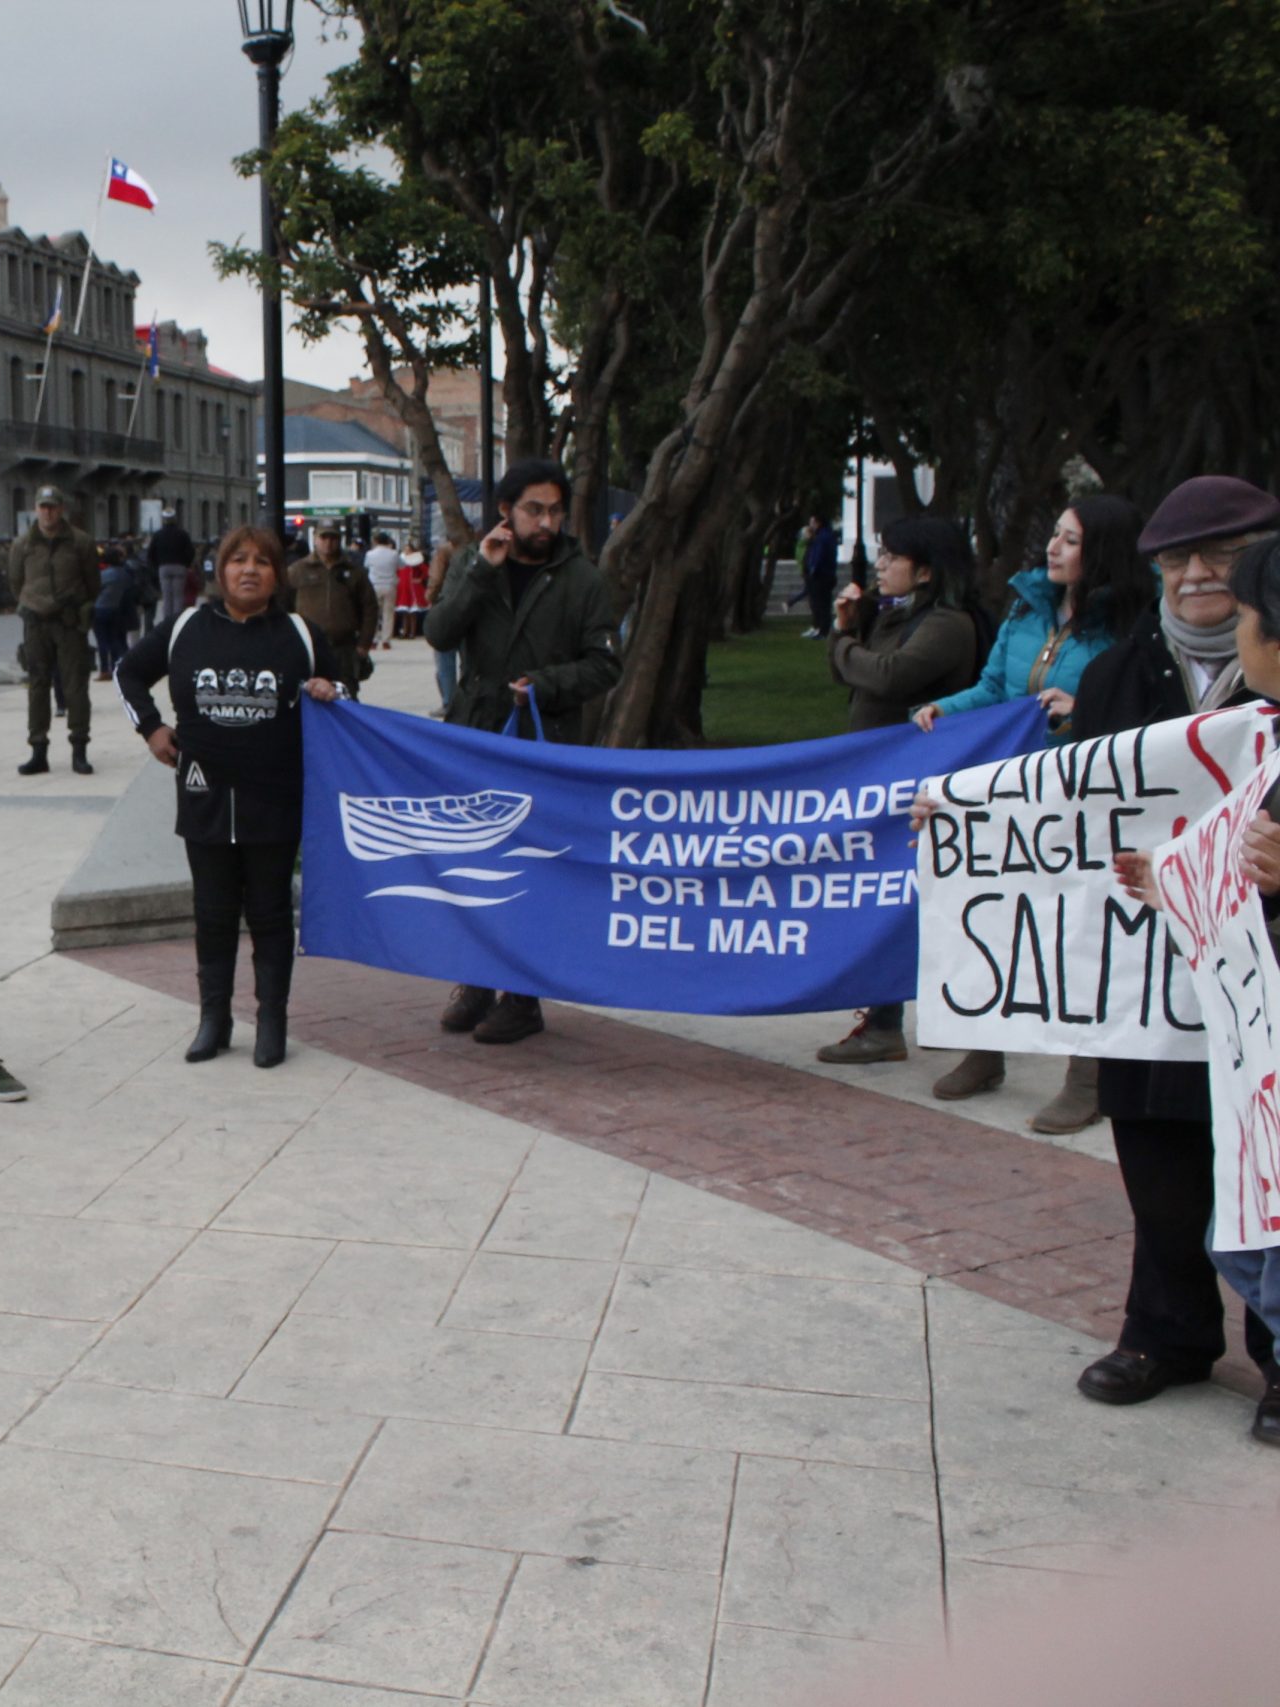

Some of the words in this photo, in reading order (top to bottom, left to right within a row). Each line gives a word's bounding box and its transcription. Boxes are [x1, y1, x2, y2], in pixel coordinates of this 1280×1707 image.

[942, 726, 1180, 807] CANAL
[610, 826, 874, 868] KAWÉSQAR
[610, 872, 705, 906] POR
[719, 874, 777, 908] LA
[607, 913, 695, 952] DEL
[707, 918, 809, 955] MAR
